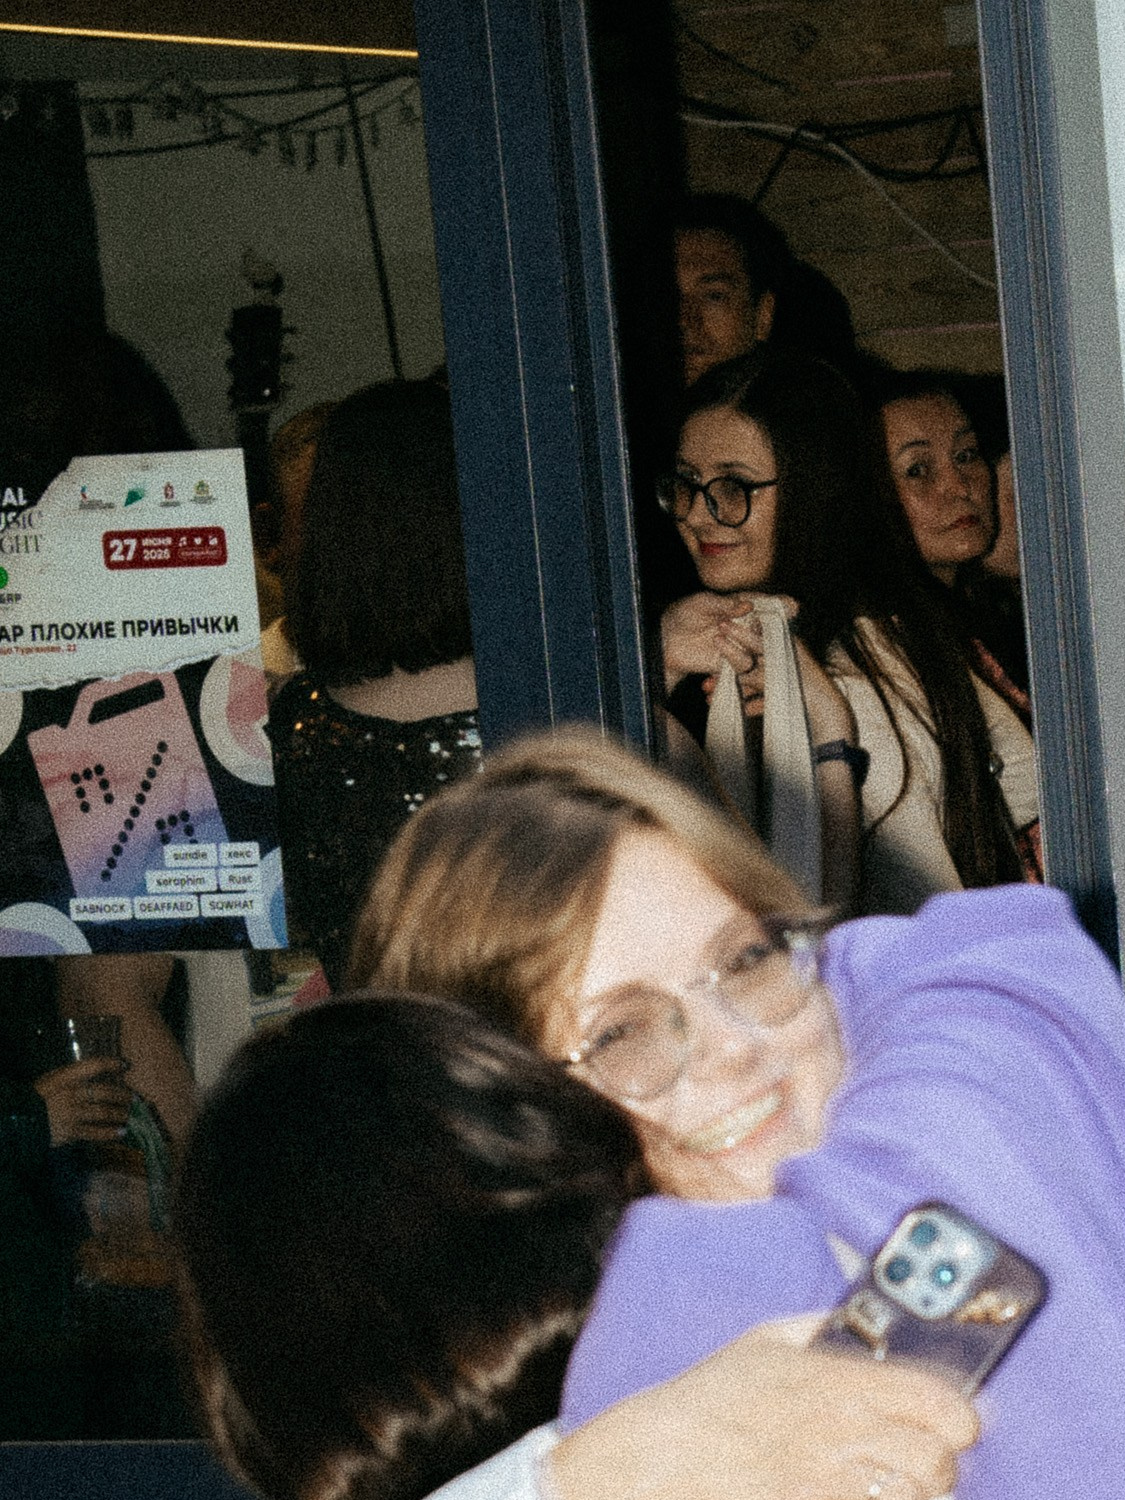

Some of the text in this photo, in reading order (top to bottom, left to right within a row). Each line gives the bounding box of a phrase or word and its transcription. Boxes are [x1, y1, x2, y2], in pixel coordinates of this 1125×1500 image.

[109, 538, 138, 562] 27
[31, 620, 116, 642] ПЛОХИЕ
[122, 615, 239, 638] ПРИВЫЧКИ
[75, 902, 125, 914] SABNOCK
